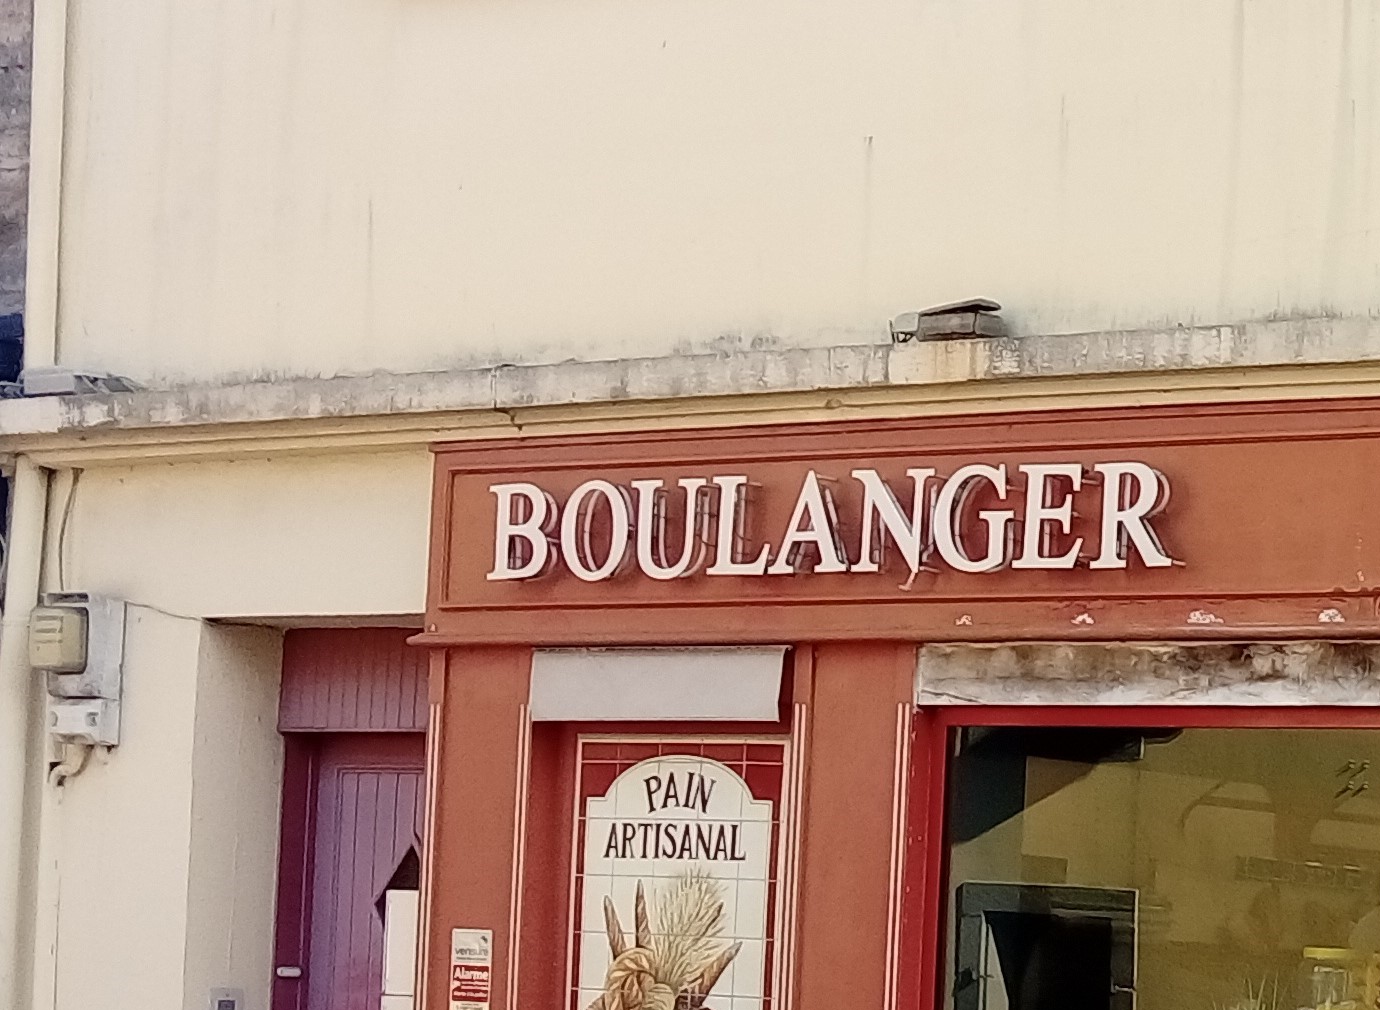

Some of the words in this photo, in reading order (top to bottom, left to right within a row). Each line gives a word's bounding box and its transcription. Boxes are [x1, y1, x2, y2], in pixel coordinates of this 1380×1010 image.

[487, 461, 1174, 581] BOULANGER
[642, 771, 717, 815] PAIN
[603, 822, 748, 861] ARTISANAL
[453, 966, 489, 981] Alarme
